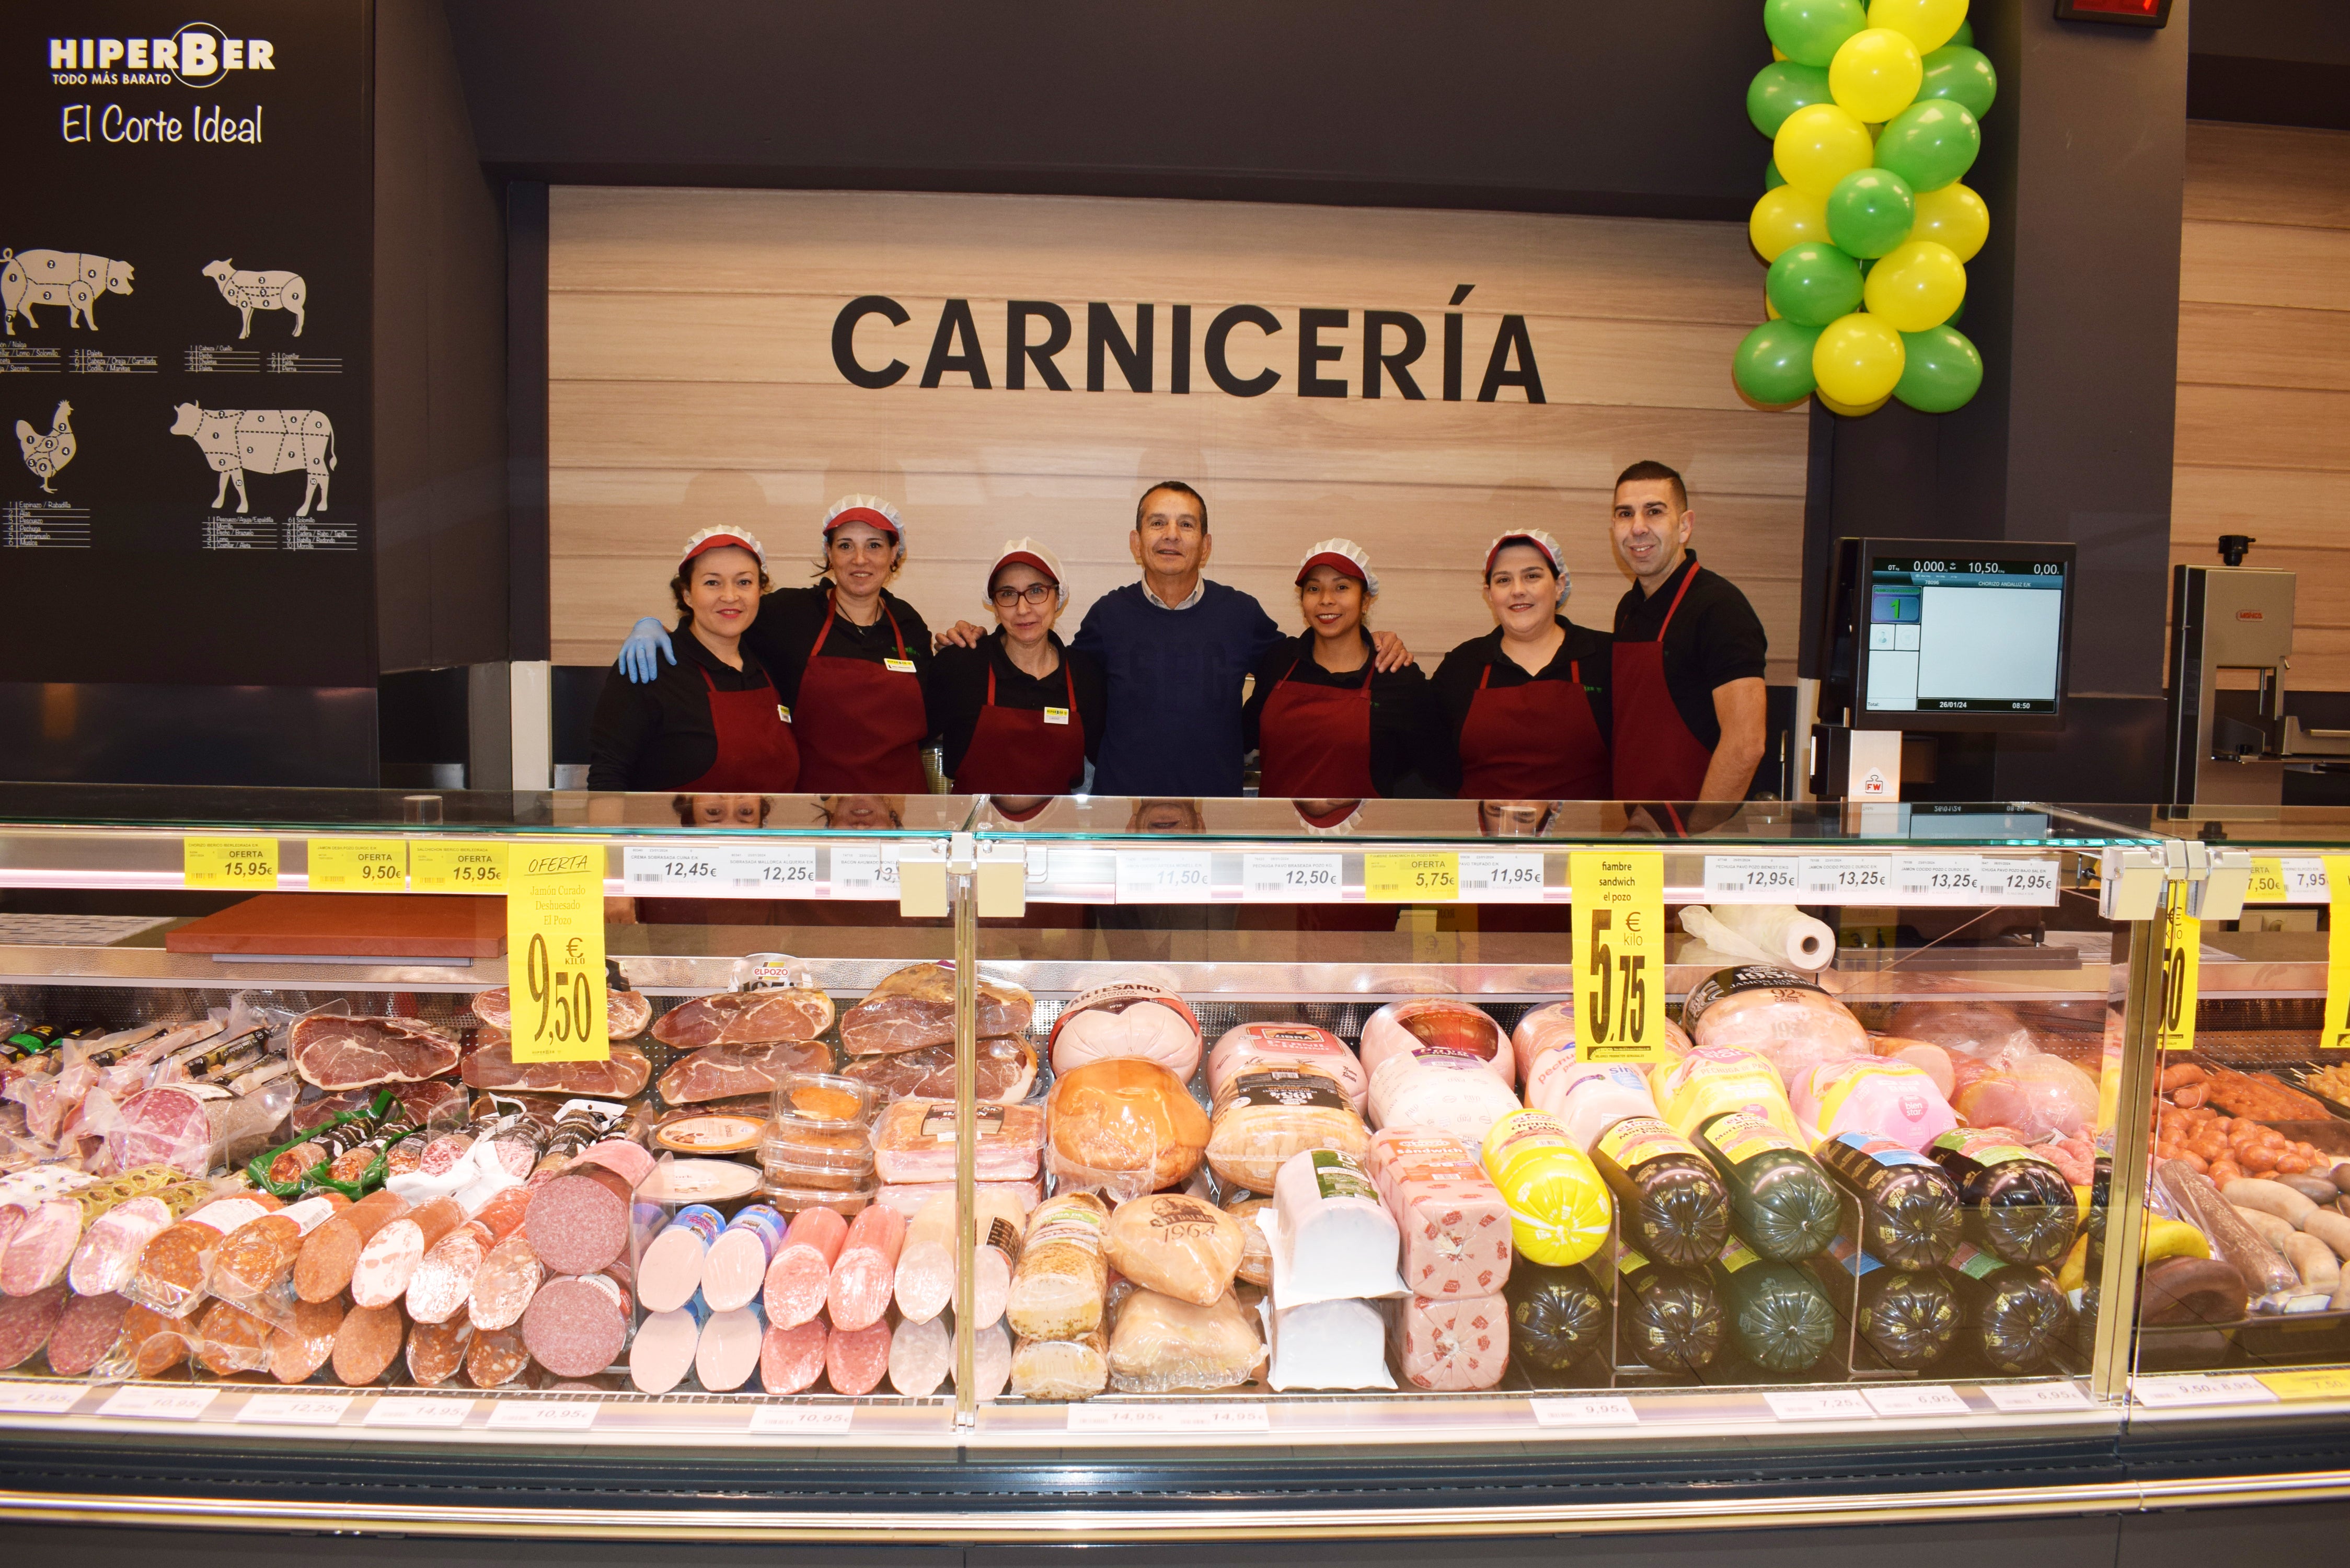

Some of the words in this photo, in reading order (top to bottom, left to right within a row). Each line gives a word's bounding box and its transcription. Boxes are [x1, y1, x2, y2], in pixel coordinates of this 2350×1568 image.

[50, 32, 275, 76] HIPERBER
[53, 74, 87, 85] TODO
[92, 72, 118, 85] MÁS
[122, 74, 171, 85] BARATO
[63, 105, 91, 143] El
[101, 104, 182, 143] Corte
[194, 106, 262, 144] Ideal
[831, 284, 1547, 404] CARNICERÍA
[1914, 561, 1944, 572] 0,000
[1968, 562, 1998, 573] 10,50
[2034, 564, 2057, 575] 0,00
[1890, 598, 1900, 619] 1
[225, 862, 272, 878] 15,95€
[528, 855, 589, 873] OFERTA
[665, 862, 717, 878] 12,45€
[1602, 861, 1632, 871] fiambre
[362, 866, 401, 881] 9,50€
[453, 867, 501, 882] 15,95€
[763, 867, 814, 882] 12,25€
[1156, 870, 1208, 886] 11,50€
[1285, 870, 1337, 886] 12,50€
[1415, 872, 1455, 888] 5,75€
[1491, 869, 1540, 884] 11,95€
[1747, 872, 1795, 887] 12,95€
[1838, 872, 1885, 887] 13,25€
[1599, 877, 1635, 886] sandwich
[1931, 874, 1977, 889] 13,25€
[2006, 875, 2052, 890] 12,95€
[531, 885, 556, 896] Jamón
[558, 884, 585, 895] Curado
[1603, 892, 1610, 901] el
[1612, 894, 1631, 903] pozo
[535, 900, 581, 910] Deshuesado
[544, 915, 551, 925] El
[554, 915, 572, 925] Pozo
[1626, 912, 1641, 932] €
[1623, 932, 1643, 946] kilo
[566, 937, 584, 958] €
[1589, 909, 1645, 1044] 5,75
[1735, 971, 1800, 981] 1954
[528, 933, 592, 1046] 9,50
[1069, 984, 1161, 1008] ARTESANO
[1700, 1066, 1740, 1075] PECHUGA
[1165, 1223, 1216, 1243] 1964
